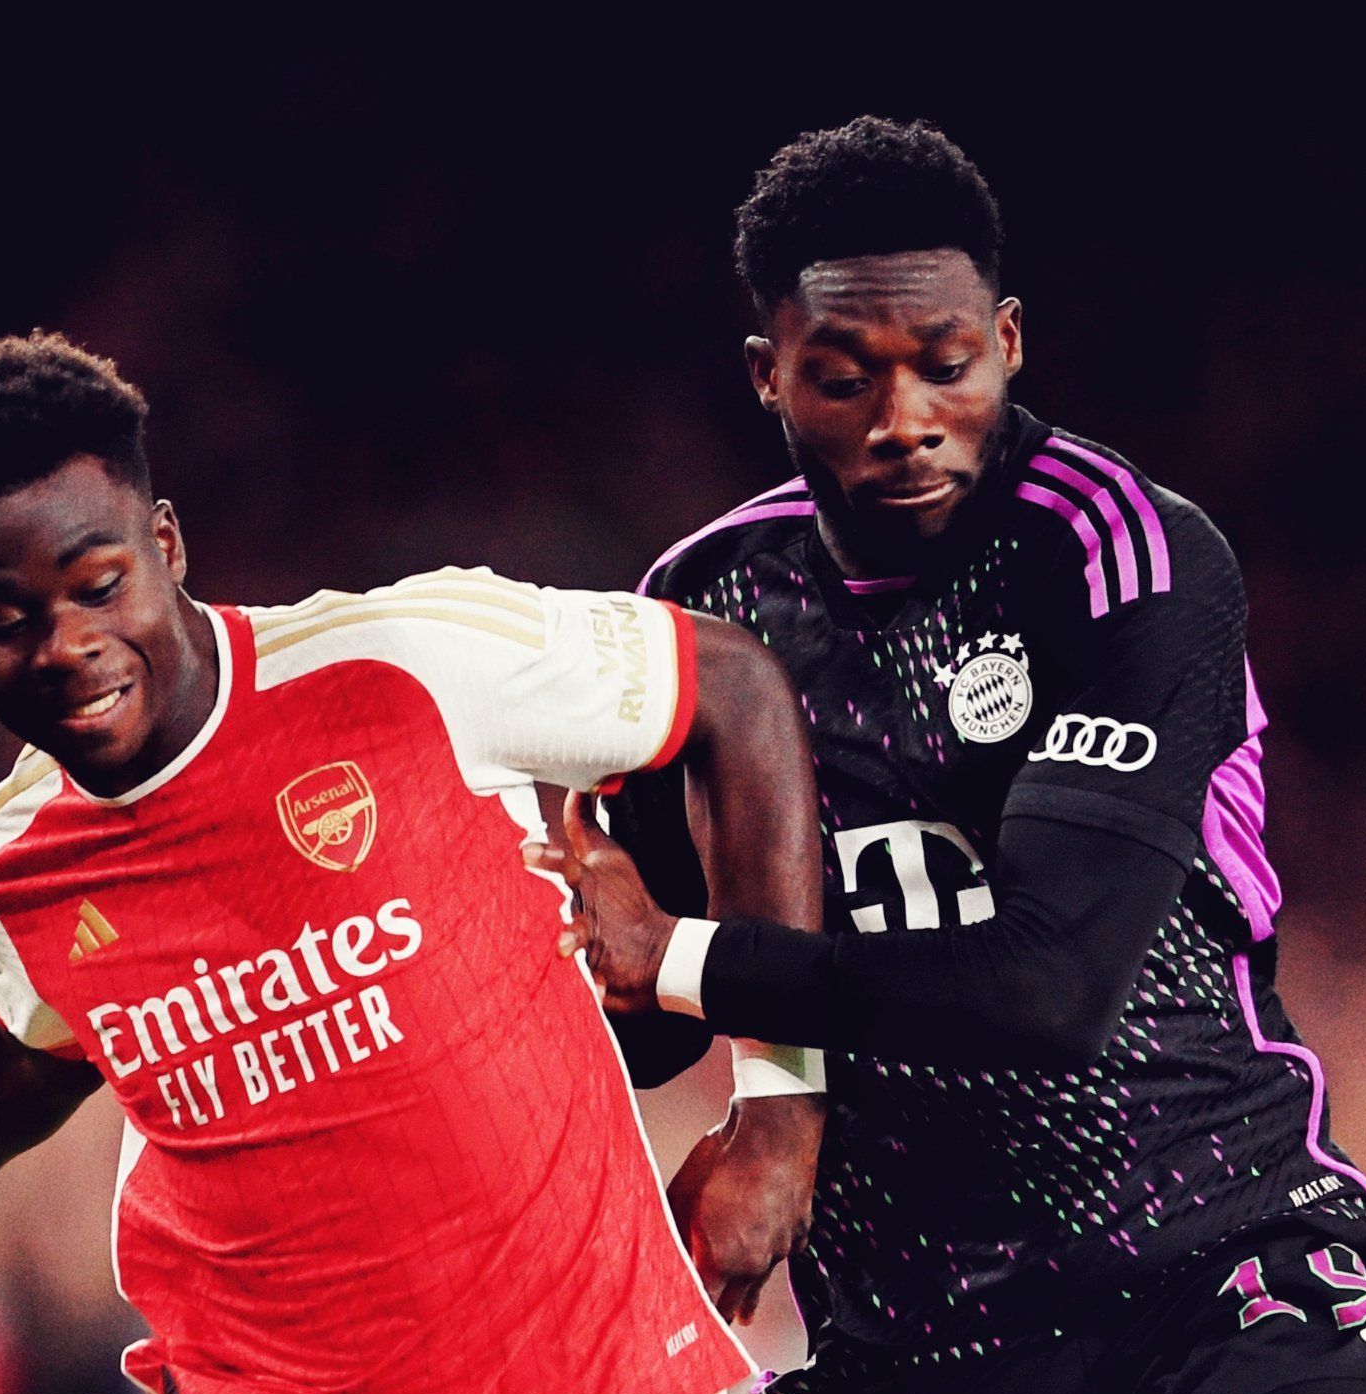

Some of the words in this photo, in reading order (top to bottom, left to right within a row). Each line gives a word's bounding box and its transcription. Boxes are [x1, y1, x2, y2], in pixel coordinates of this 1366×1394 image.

[956, 678, 970, 697] FC
[970, 661, 1022, 686] BAYERN
[293, 776, 356, 818] Arsenal
[87, 898, 423, 1080] Emirates
[156, 1054, 225, 1130] FLY
[232, 984, 404, 1106] BETTER
